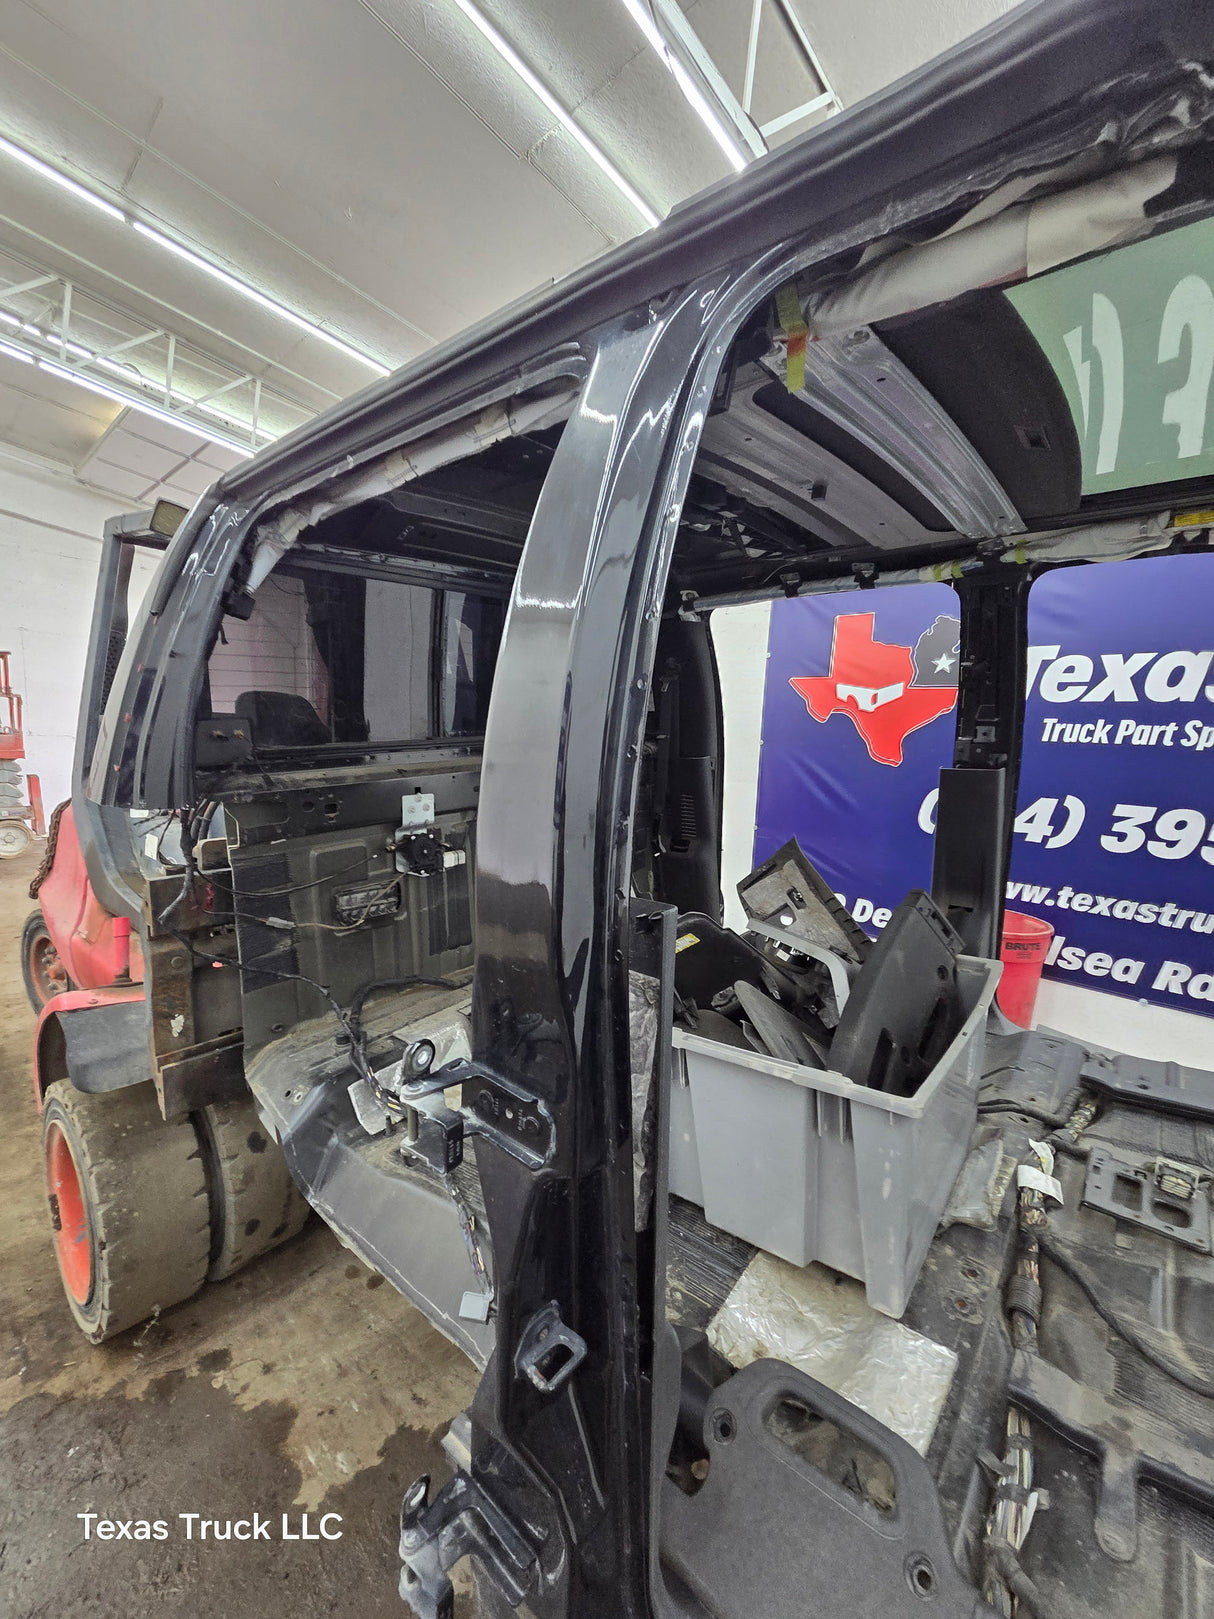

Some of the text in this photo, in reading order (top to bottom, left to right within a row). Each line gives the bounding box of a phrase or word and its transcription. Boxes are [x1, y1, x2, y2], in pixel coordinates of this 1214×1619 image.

[1026, 645, 1214, 703] Texa
[1041, 718, 1113, 744] Truck
[1114, 719, 1178, 746] Part
[1100, 803, 1214, 866] 39
[1005, 942, 1041, 951] BRUTE
